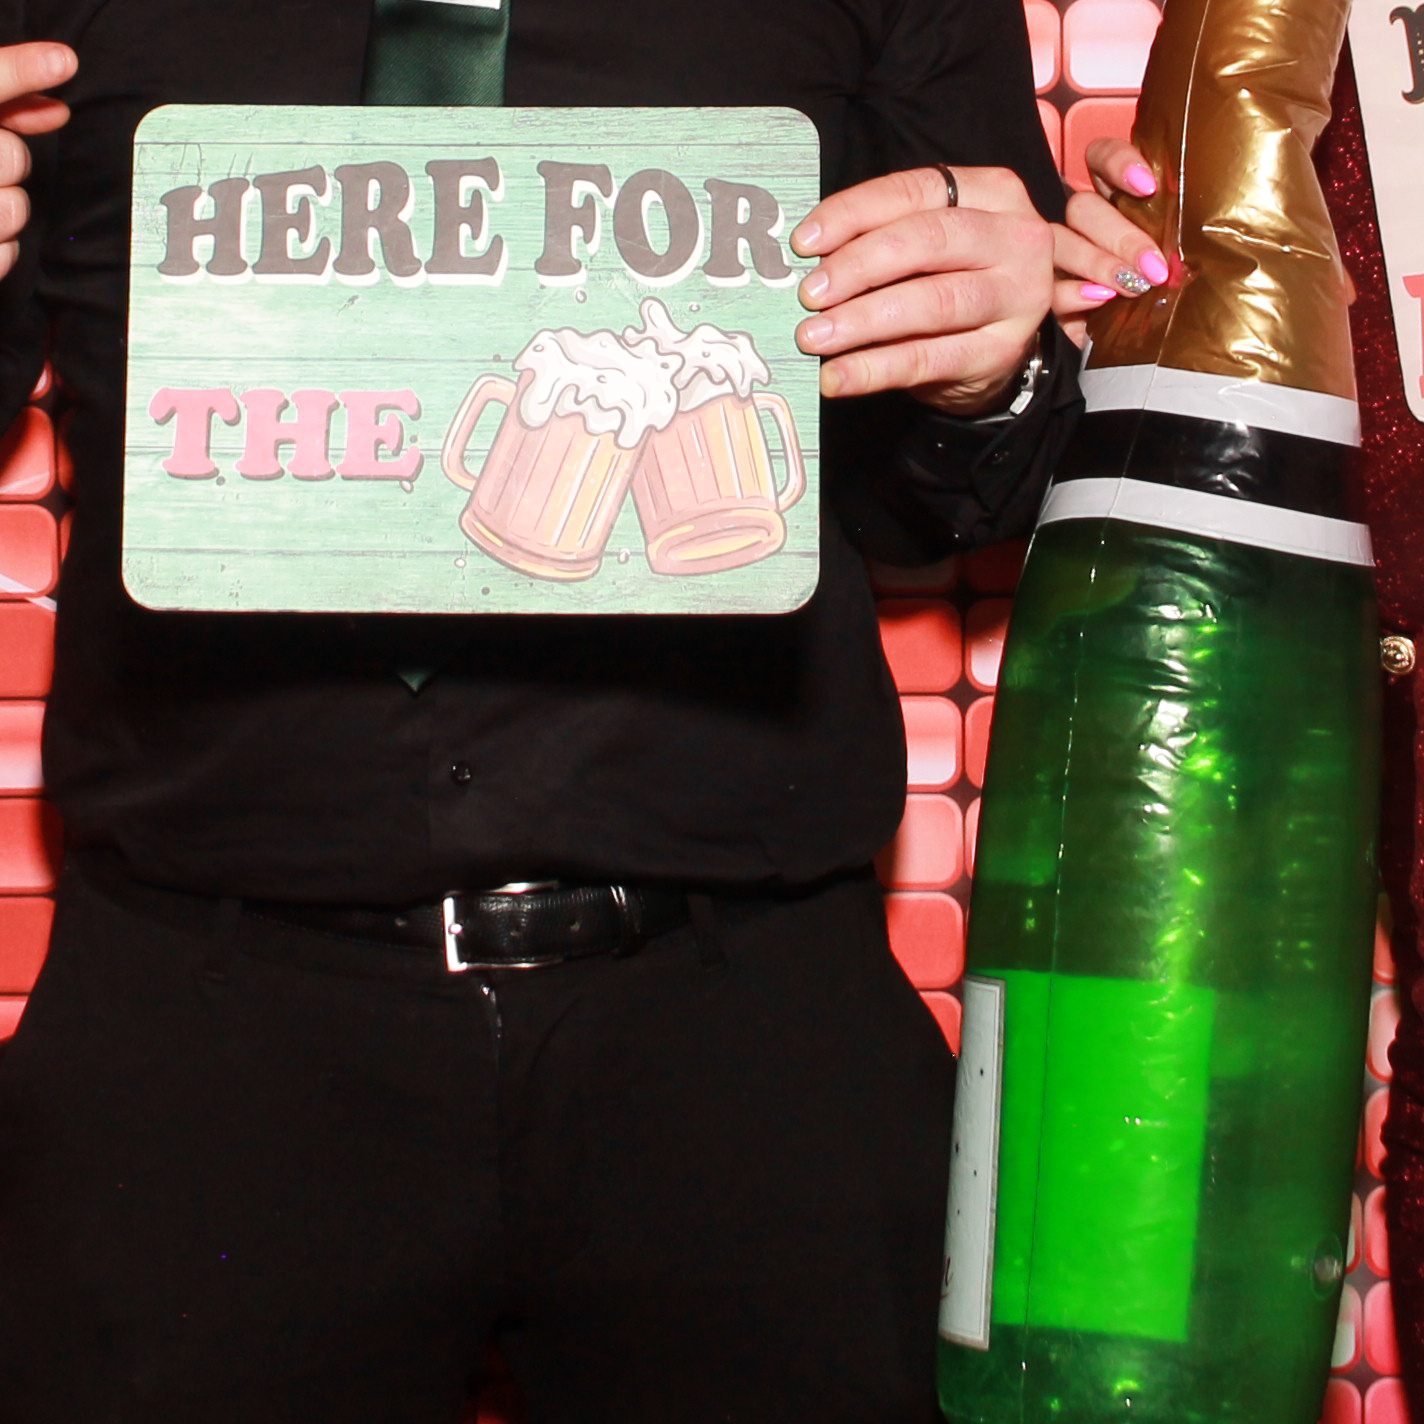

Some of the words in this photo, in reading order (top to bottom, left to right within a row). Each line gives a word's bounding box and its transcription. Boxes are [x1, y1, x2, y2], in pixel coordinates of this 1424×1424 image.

[157, 157, 507, 286] HERE
[533, 159, 797, 286] FOR
[148, 387, 422, 481] THE
